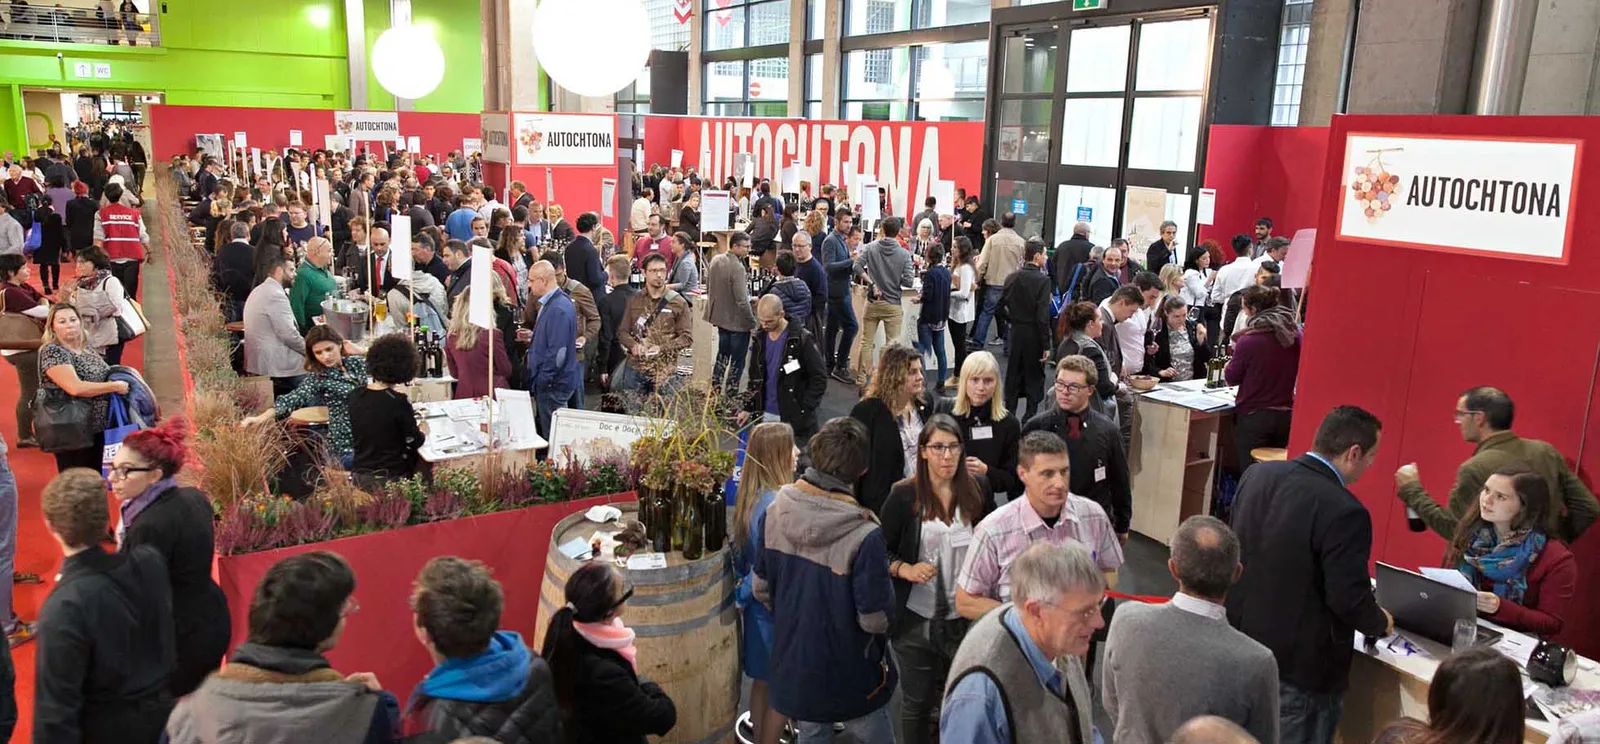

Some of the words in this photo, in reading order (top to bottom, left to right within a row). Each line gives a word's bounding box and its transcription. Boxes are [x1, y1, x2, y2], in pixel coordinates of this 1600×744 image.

[96, 66, 109, 75] WC
[356, 121, 397, 131] AUTOCHTONA
[547, 131, 612, 148] AUTOCHTONA
[699, 122, 939, 226] AUTOCHTONA
[1406, 175, 1562, 218] AUTOCHTONA
[599, 422, 613, 431] Doc
